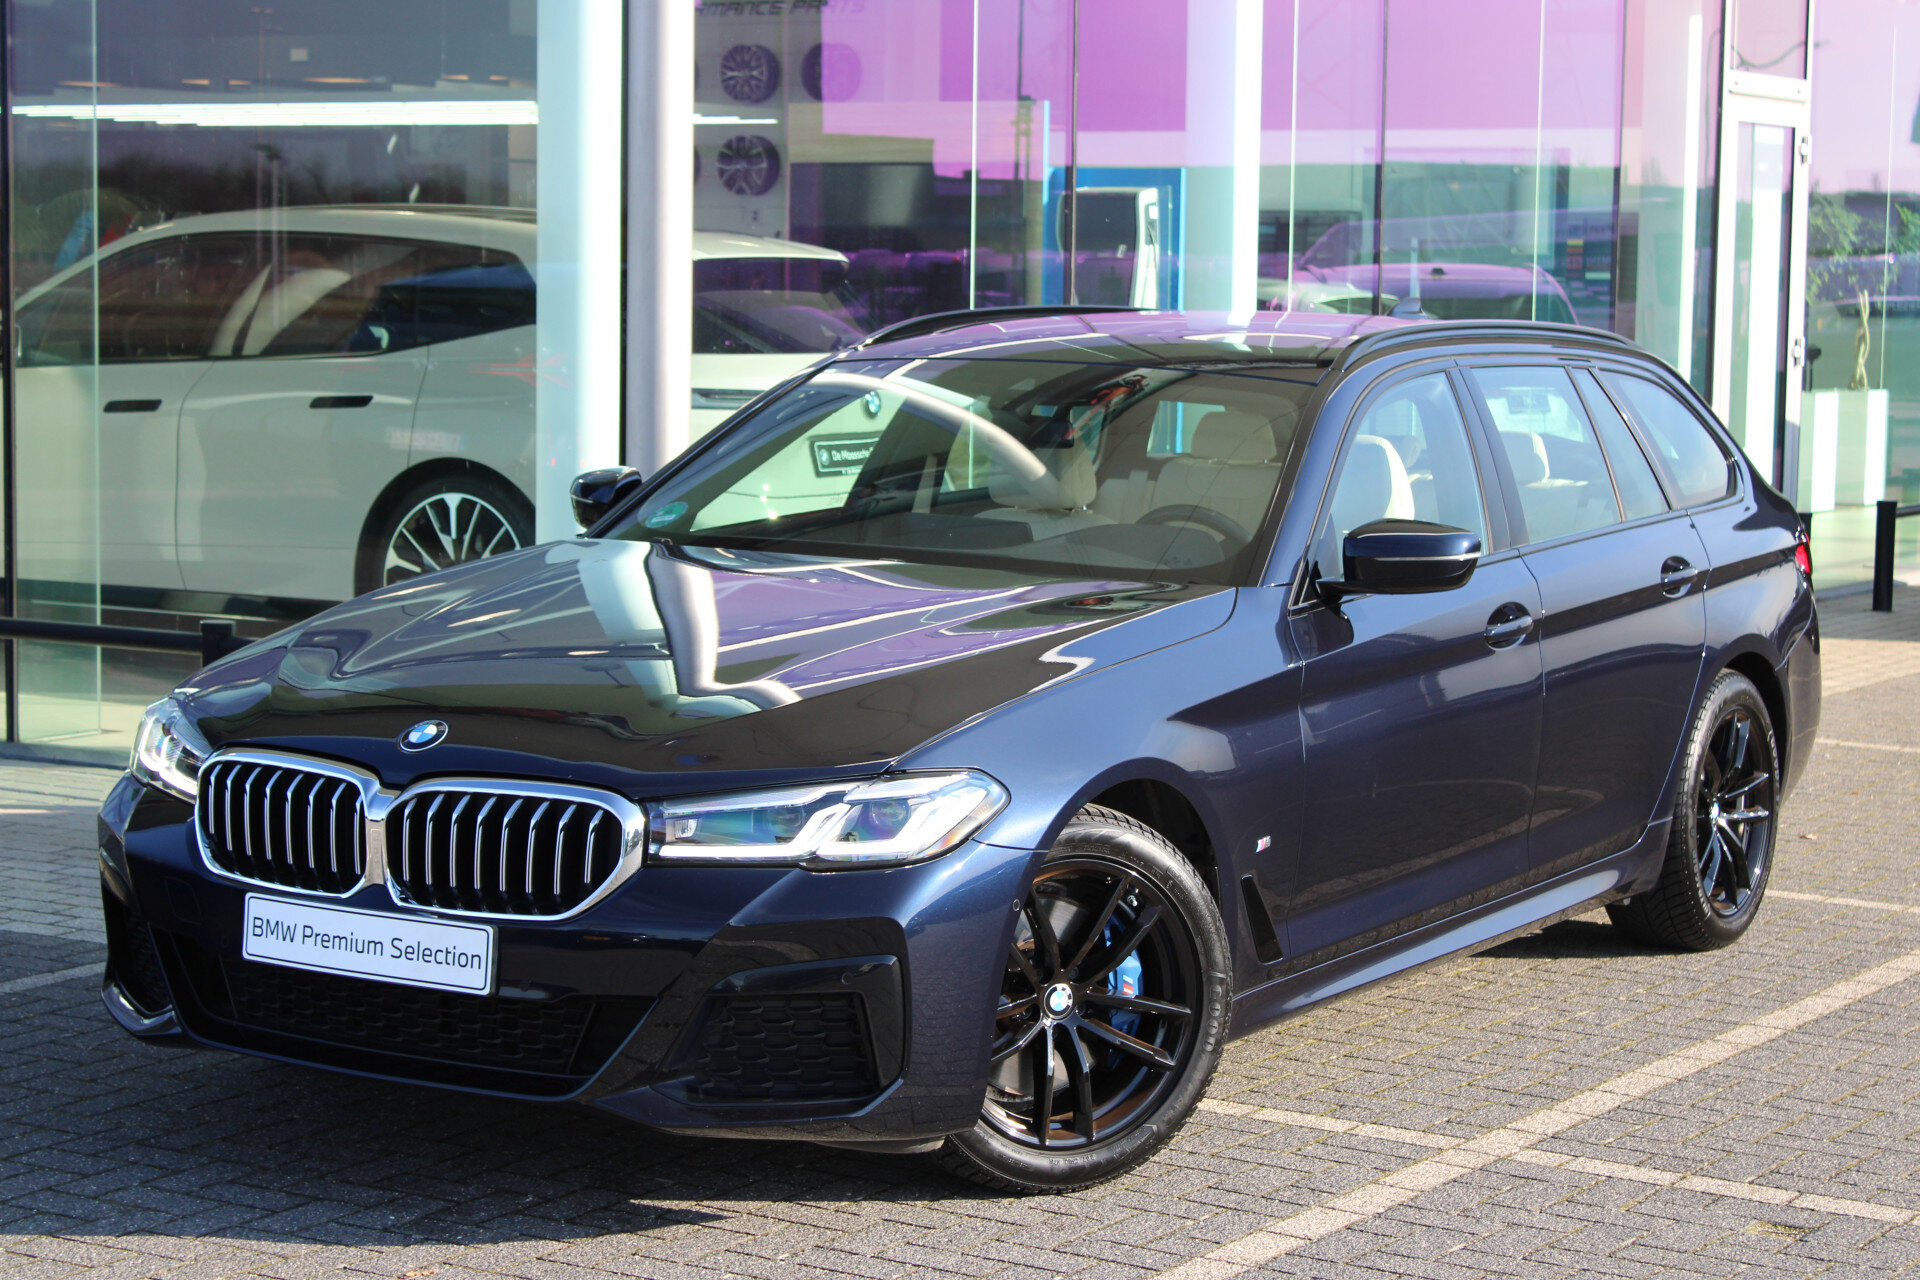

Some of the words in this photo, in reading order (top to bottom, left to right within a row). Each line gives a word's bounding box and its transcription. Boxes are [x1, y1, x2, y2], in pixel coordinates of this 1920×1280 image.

[252, 917, 297, 943] BMW
[301, 925, 384, 957] Premium
[390, 937, 482, 970] Selection
